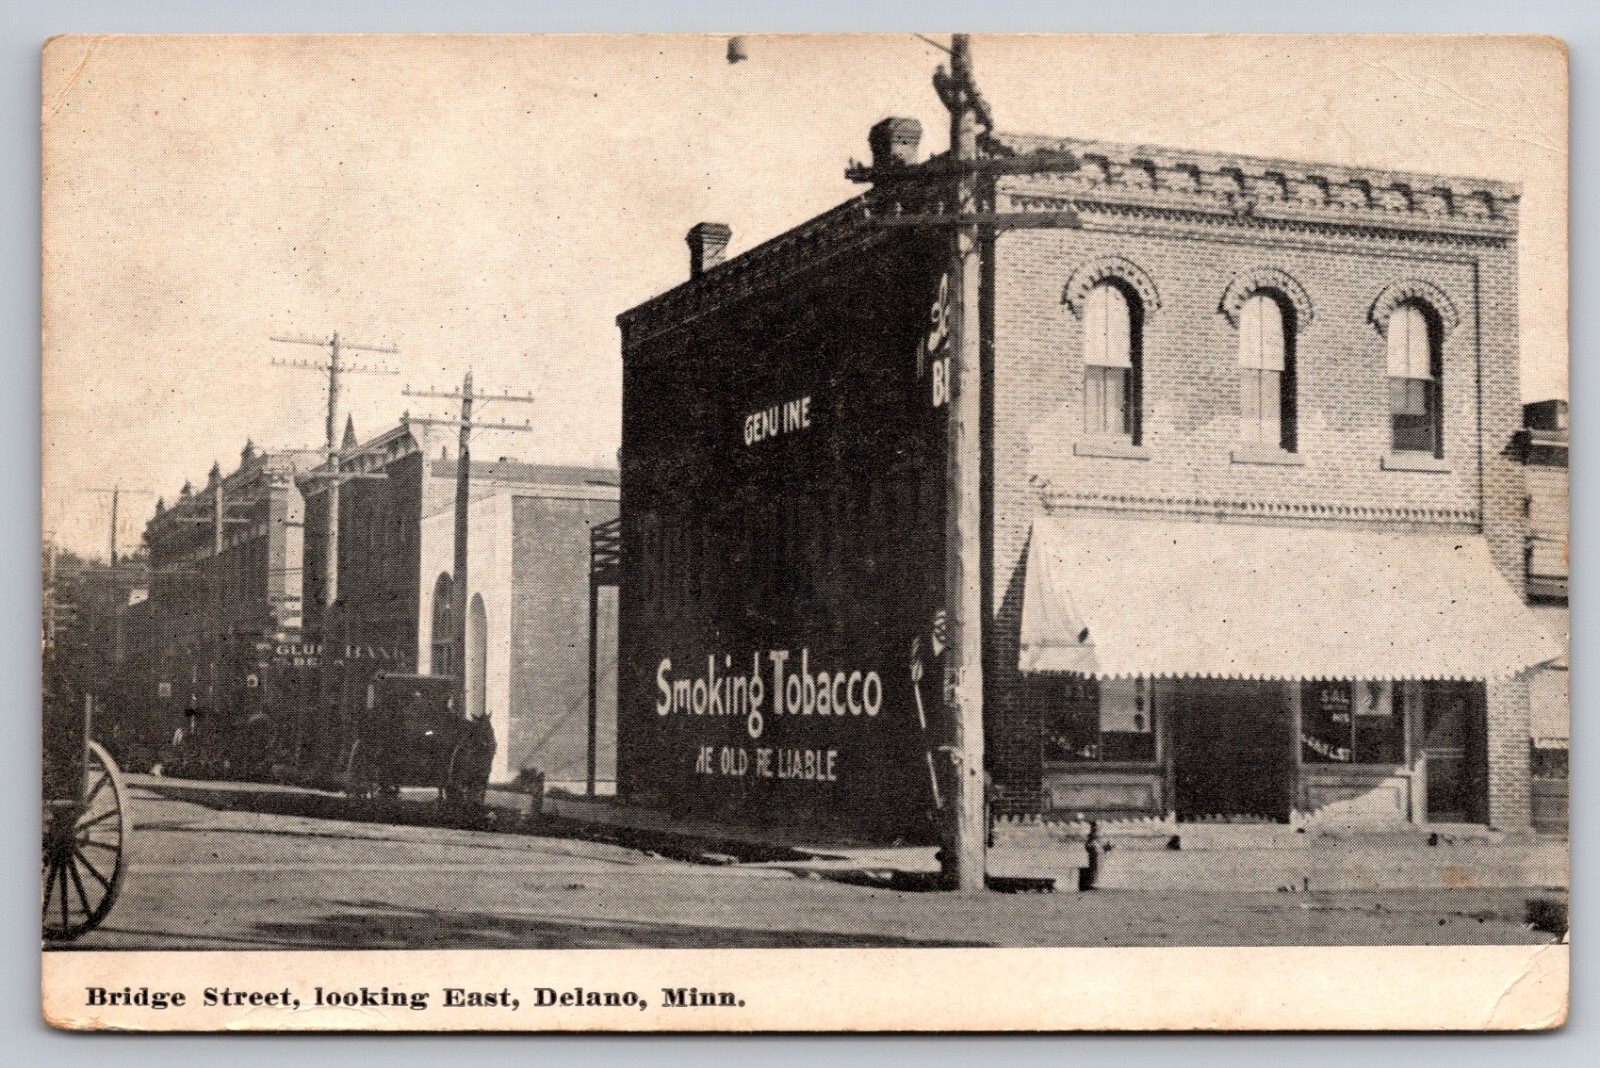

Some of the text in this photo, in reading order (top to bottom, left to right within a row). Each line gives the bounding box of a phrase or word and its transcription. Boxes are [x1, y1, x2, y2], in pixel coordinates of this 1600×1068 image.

[743, 396, 811, 446] GENUINE
[656, 648, 883, 739] Smoking Tobacco
[721, 747, 749, 776] OLD
